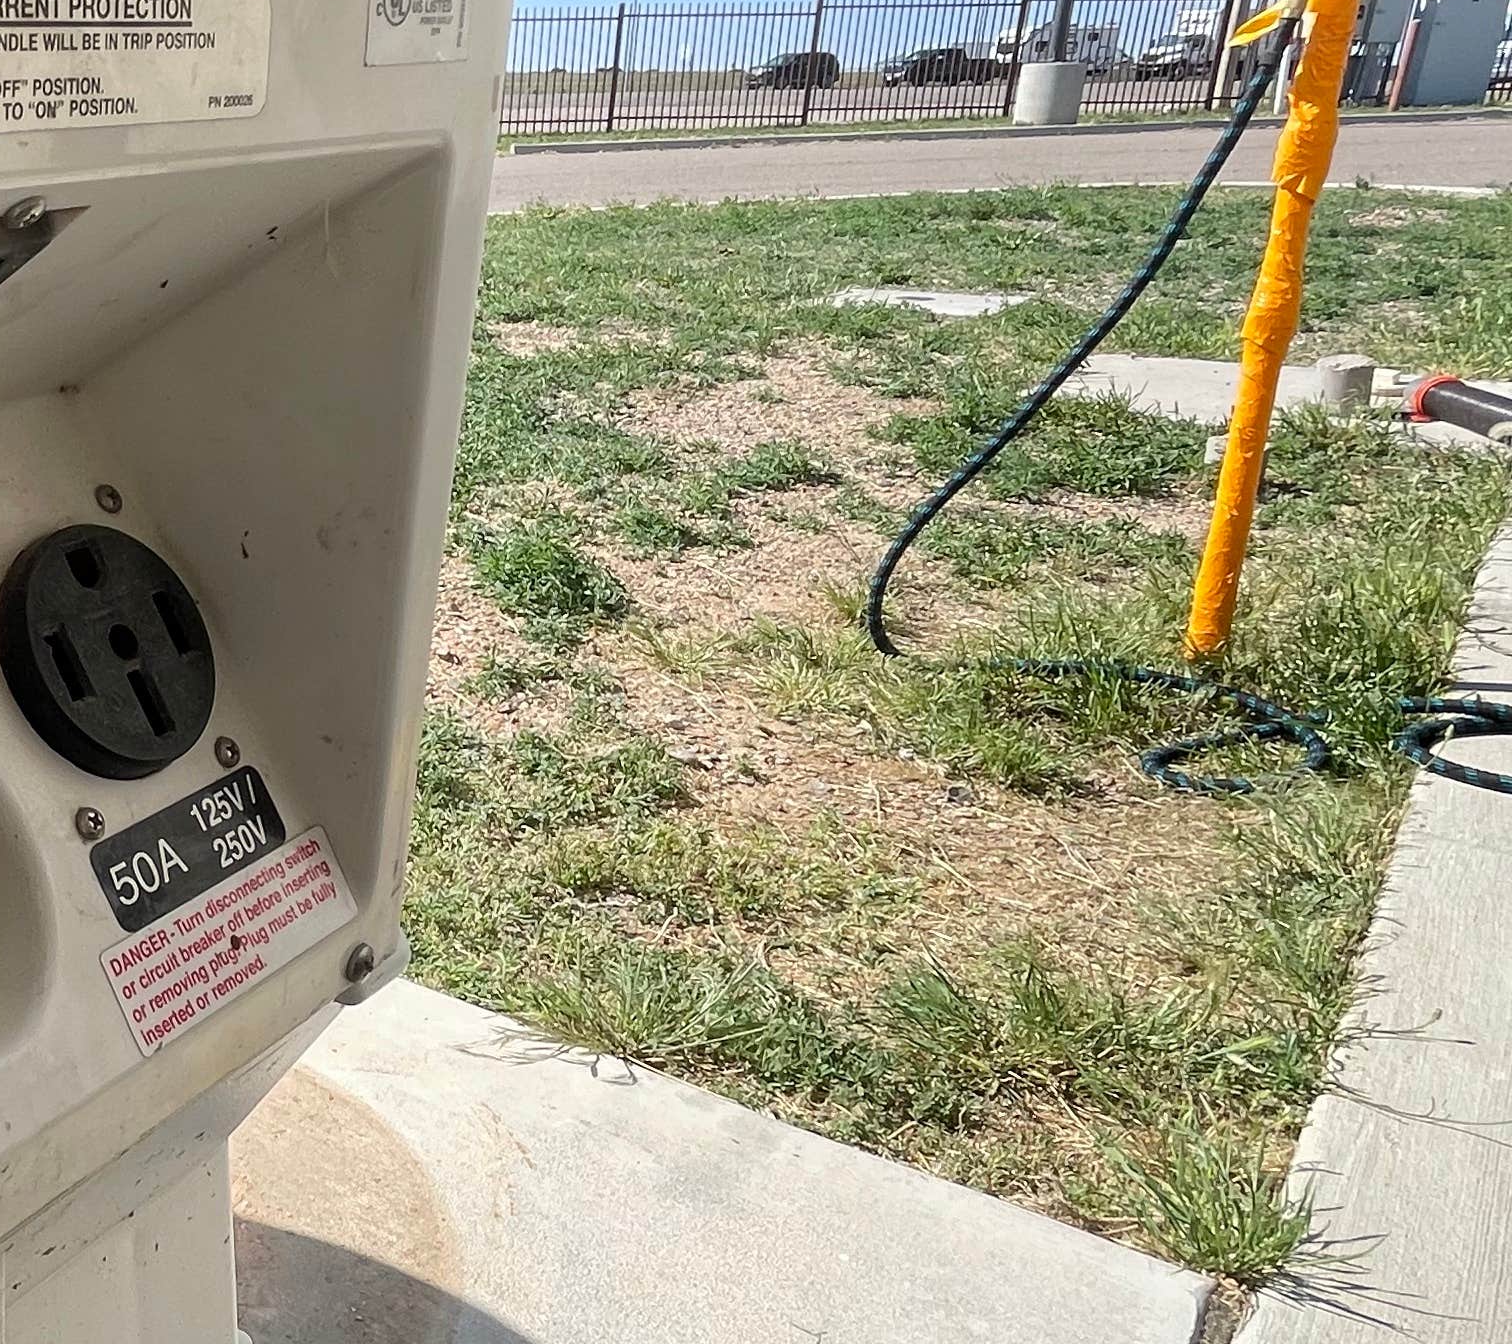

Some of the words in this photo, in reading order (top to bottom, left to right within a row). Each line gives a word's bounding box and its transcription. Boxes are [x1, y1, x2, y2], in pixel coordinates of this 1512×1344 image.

[43, 33, 78, 52] WILL
[82, 32, 101, 51] BE
[104, 32, 119, 51] IN
[122, 32, 153, 50] TRIP
[156, 31, 216, 50] POSITION
[3, 102, 24, 121] TO
[69, 97, 138, 117] POSITION.
[32, 77, 105, 97] POSITION.
[208, 95, 221, 108] PN
[212, 814, 268, 869] 250V
[109, 838, 189, 906] 50A
[173, 914, 205, 937] Turn
[206, 859, 286, 919] disconnecting
[285, 838, 321, 870] switch
[122, 981, 138, 1000] or
[139, 953, 180, 989] circuit
[181, 925, 226, 964] breaker
[228, 912, 247, 933] off
[246, 891, 282, 922] before
[283, 859, 331, 894] inserting
[132, 1003, 147, 1023] or
[148, 967, 210, 1012] removing
[240, 927, 270, 953] Plug
[269, 909, 298, 935] must
[299, 897, 313, 916] be
[312, 880, 338, 907] fully
[196, 991, 211, 1010] or
[211, 953, 268, 1000] removed.
